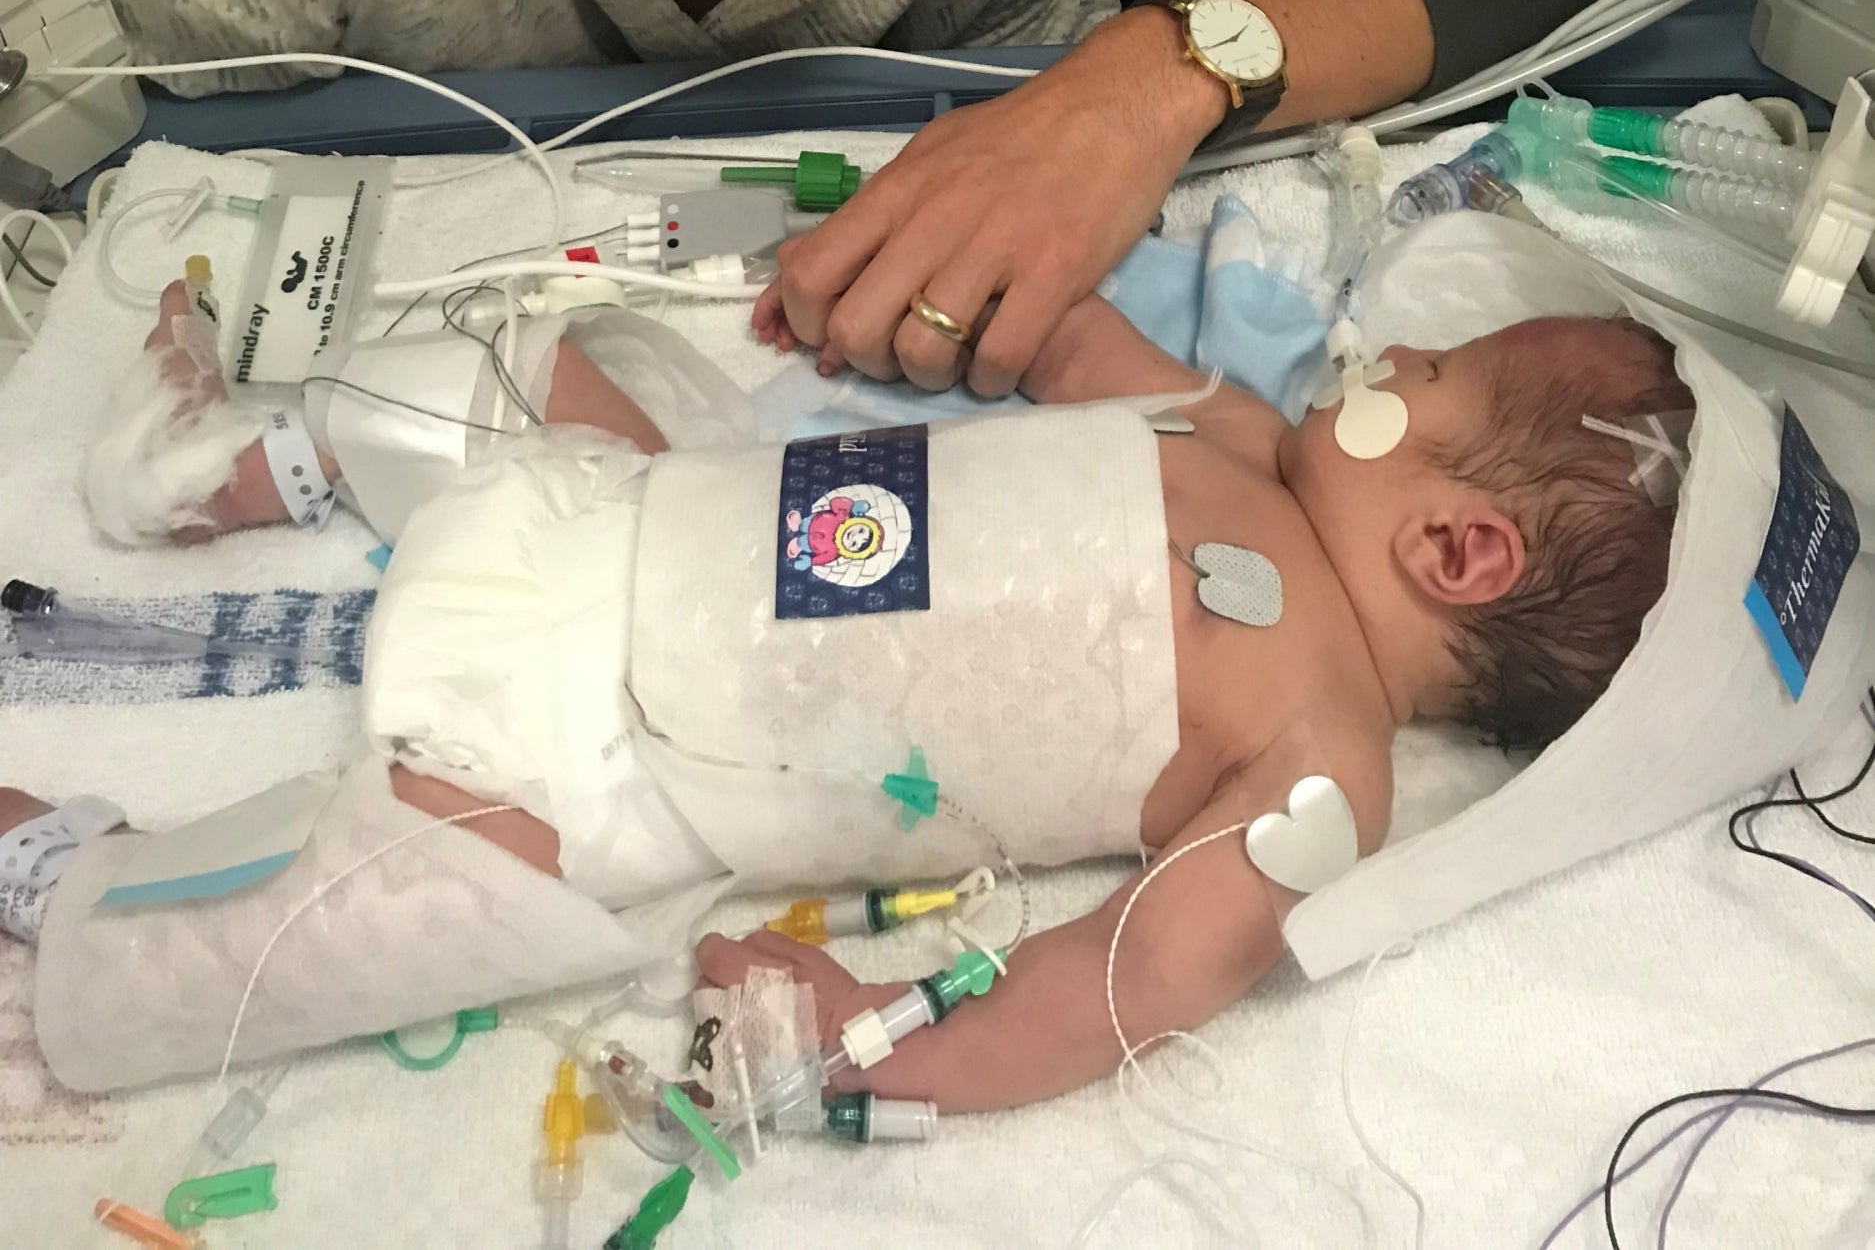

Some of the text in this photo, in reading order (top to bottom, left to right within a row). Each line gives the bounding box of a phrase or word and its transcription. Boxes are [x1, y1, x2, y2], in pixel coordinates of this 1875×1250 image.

[307, 236, 335, 310] CM 1500C
[318, 180, 365, 348] to 10.9 cm arm circumference
[237, 304, 270, 383] mindray
